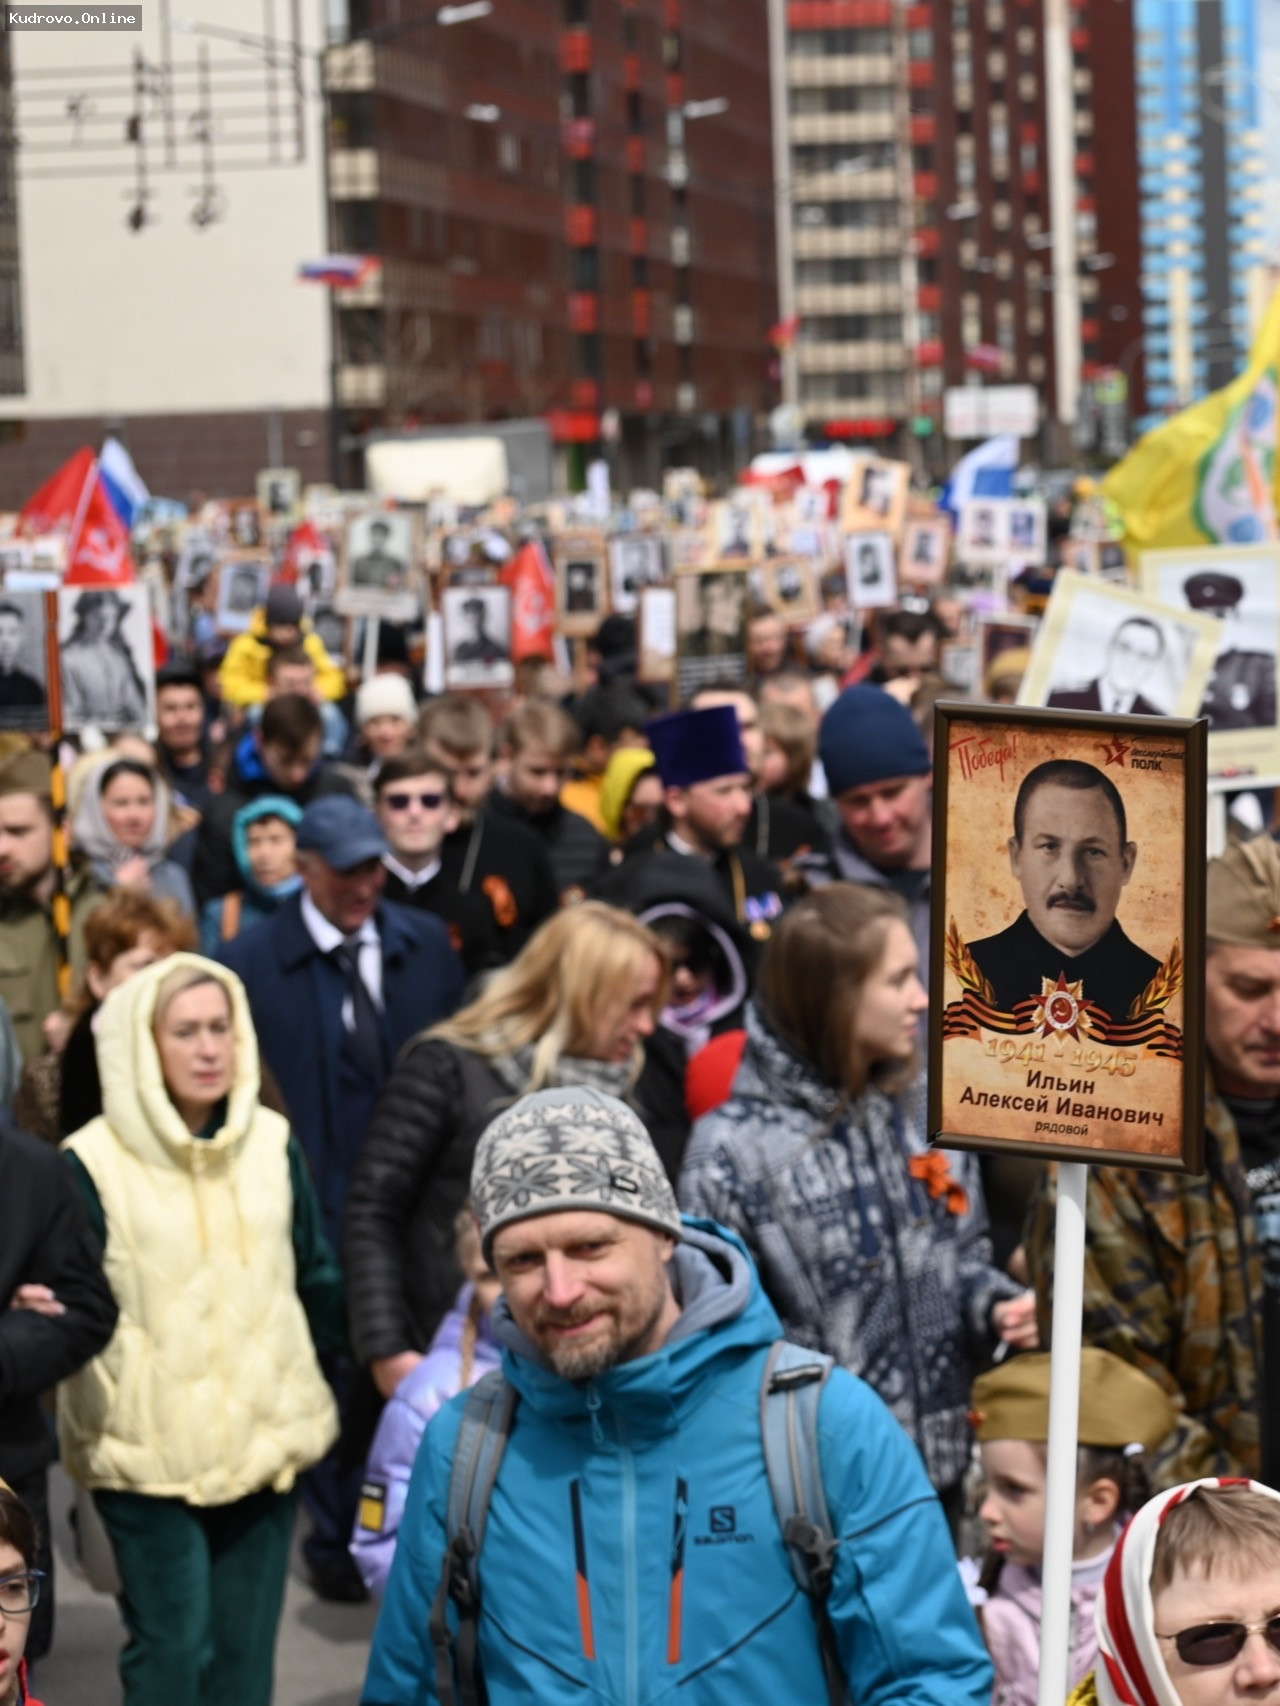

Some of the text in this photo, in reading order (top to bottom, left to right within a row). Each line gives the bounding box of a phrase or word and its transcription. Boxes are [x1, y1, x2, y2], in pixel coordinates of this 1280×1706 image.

[949, 735, 1017, 782] Победа!
[1131, 758, 1163, 771] ПОЛК
[1026, 1069, 1096, 1095] Ильин
[959, 1086, 1164, 1127] Алексей Иванович
[1034, 1120, 1089, 1136] рядовой
